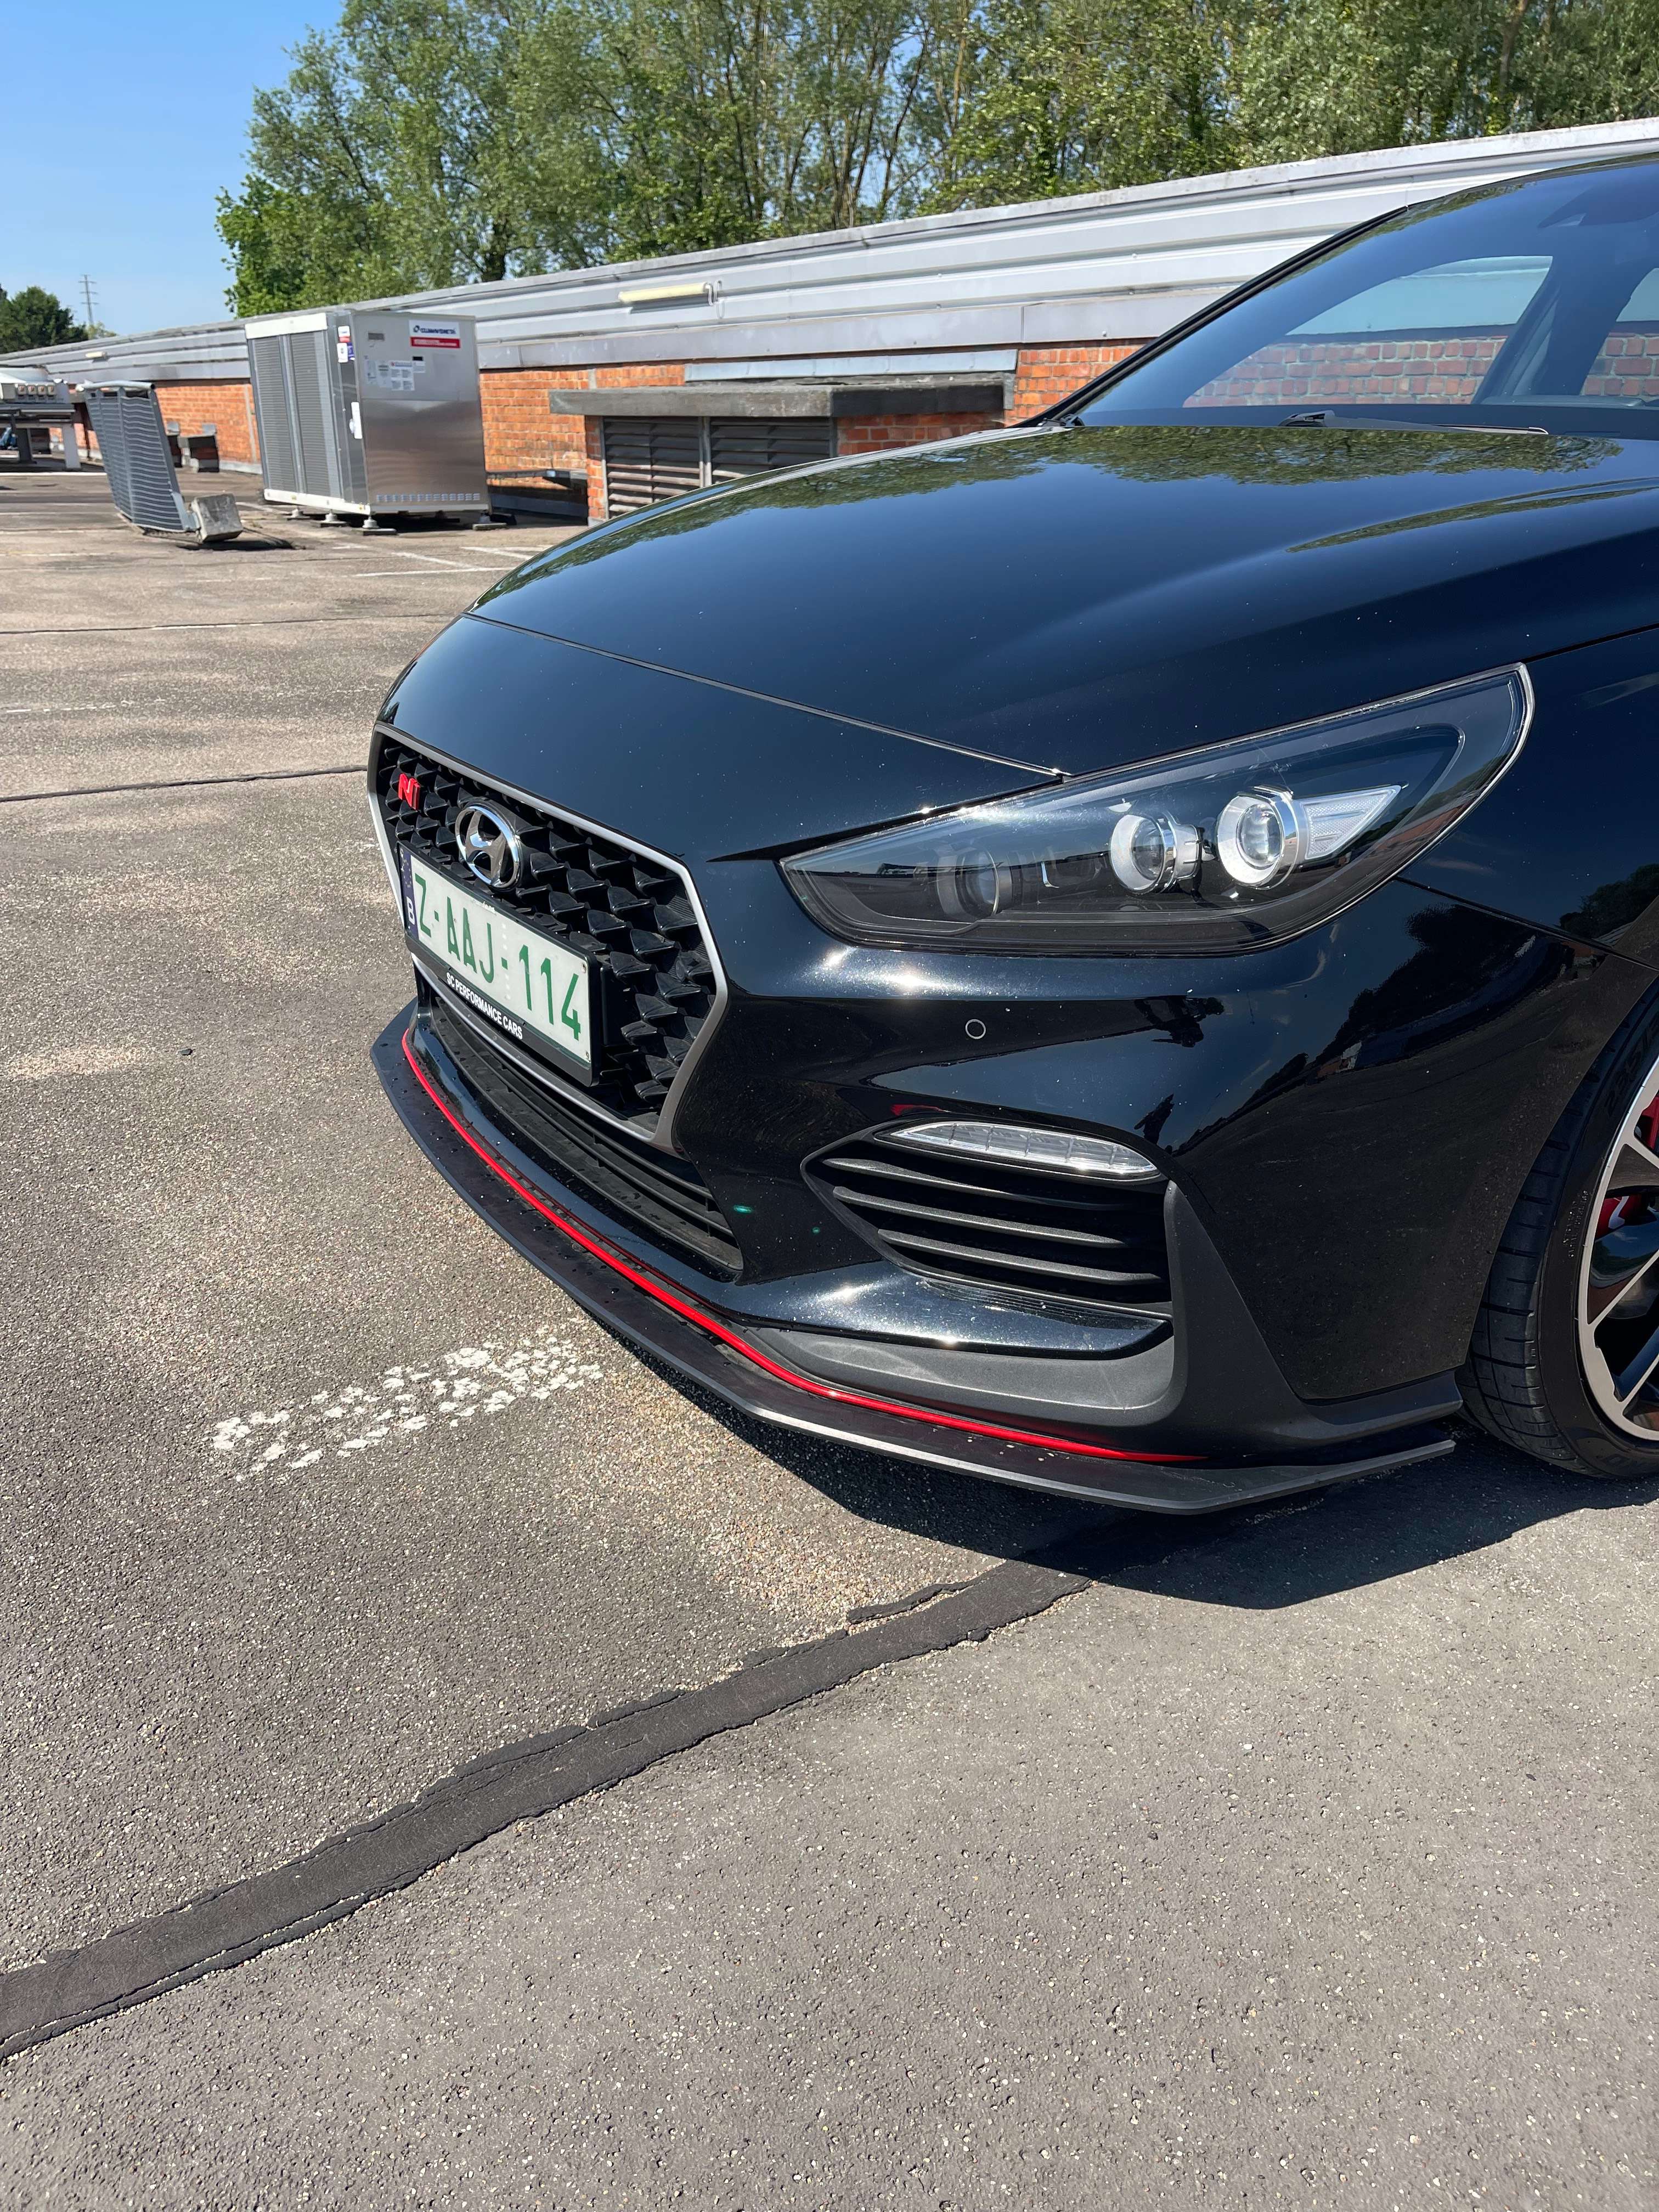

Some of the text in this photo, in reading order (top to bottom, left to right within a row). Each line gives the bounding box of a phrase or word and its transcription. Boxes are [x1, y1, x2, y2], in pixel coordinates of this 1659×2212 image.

[398, 774, 420, 810] N
[407, 896, 415, 925] B
[415, 873, 581, 1041] Z-AAJ-114
[447, 972, 523, 1040] SC PERFORMANCE CARS
